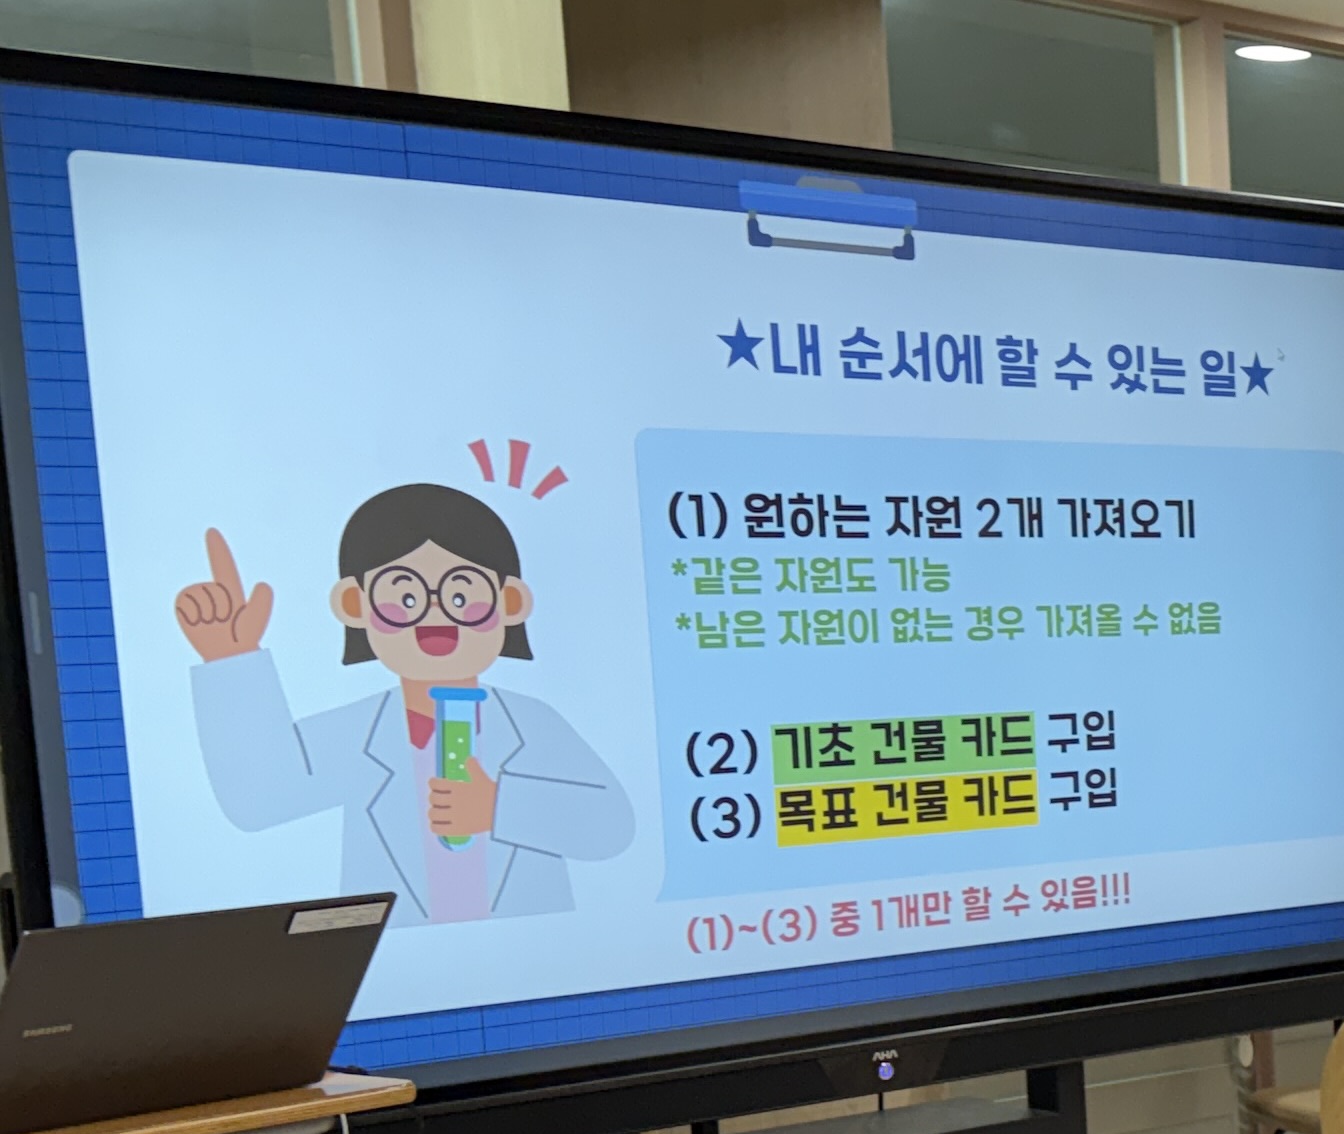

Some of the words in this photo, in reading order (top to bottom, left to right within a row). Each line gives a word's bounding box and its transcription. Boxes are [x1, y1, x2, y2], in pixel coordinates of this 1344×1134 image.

[769, 322, 822, 377] 내
[839, 326, 984, 385] 순서에
[995, 334, 1039, 388] 할
[1054, 342, 1093, 391] 수
[1107, 344, 1186, 395] 있는
[1199, 349, 1237, 398] 일
[668, 491, 728, 539] (1)
[744, 492, 871, 539] 원하는
[885, 495, 963, 539] 자원
[976, 496, 1044, 538] 2개
[1057, 497, 1196, 539] 가져오기
[774, 556, 877, 594] 자원도
[887, 556, 951, 593] 가능
[777, 607, 879, 646] 자원이
[890, 607, 954, 644] 없는
[964, 605, 1025, 642] 경우
[1035, 603, 1123, 638] 가져올
[1133, 603, 1159, 637] 수
[1168, 601, 1222, 636] 없음
[686, 729, 758, 778] (2)
[774, 722, 856, 770] 기초
[870, 719, 946, 766] 건물
[960, 715, 1034, 757] 카드
[1047, 710, 1116, 753] 구입
[690, 793, 762, 843] (3)
[778, 786, 858, 833] 목표
[873, 779, 949, 827] 건물
[963, 774, 1036, 817] 카드
[1049, 767, 1117, 812] 구입
[687, 905, 818, 954] (1)~(3)
[830, 900, 861, 938] 중
[871, 890, 952, 932] 1개만
[961, 886, 992, 922] 할
[1002, 884, 1031, 917] 수
[1040, 872, 1130, 913] 있음!!!
